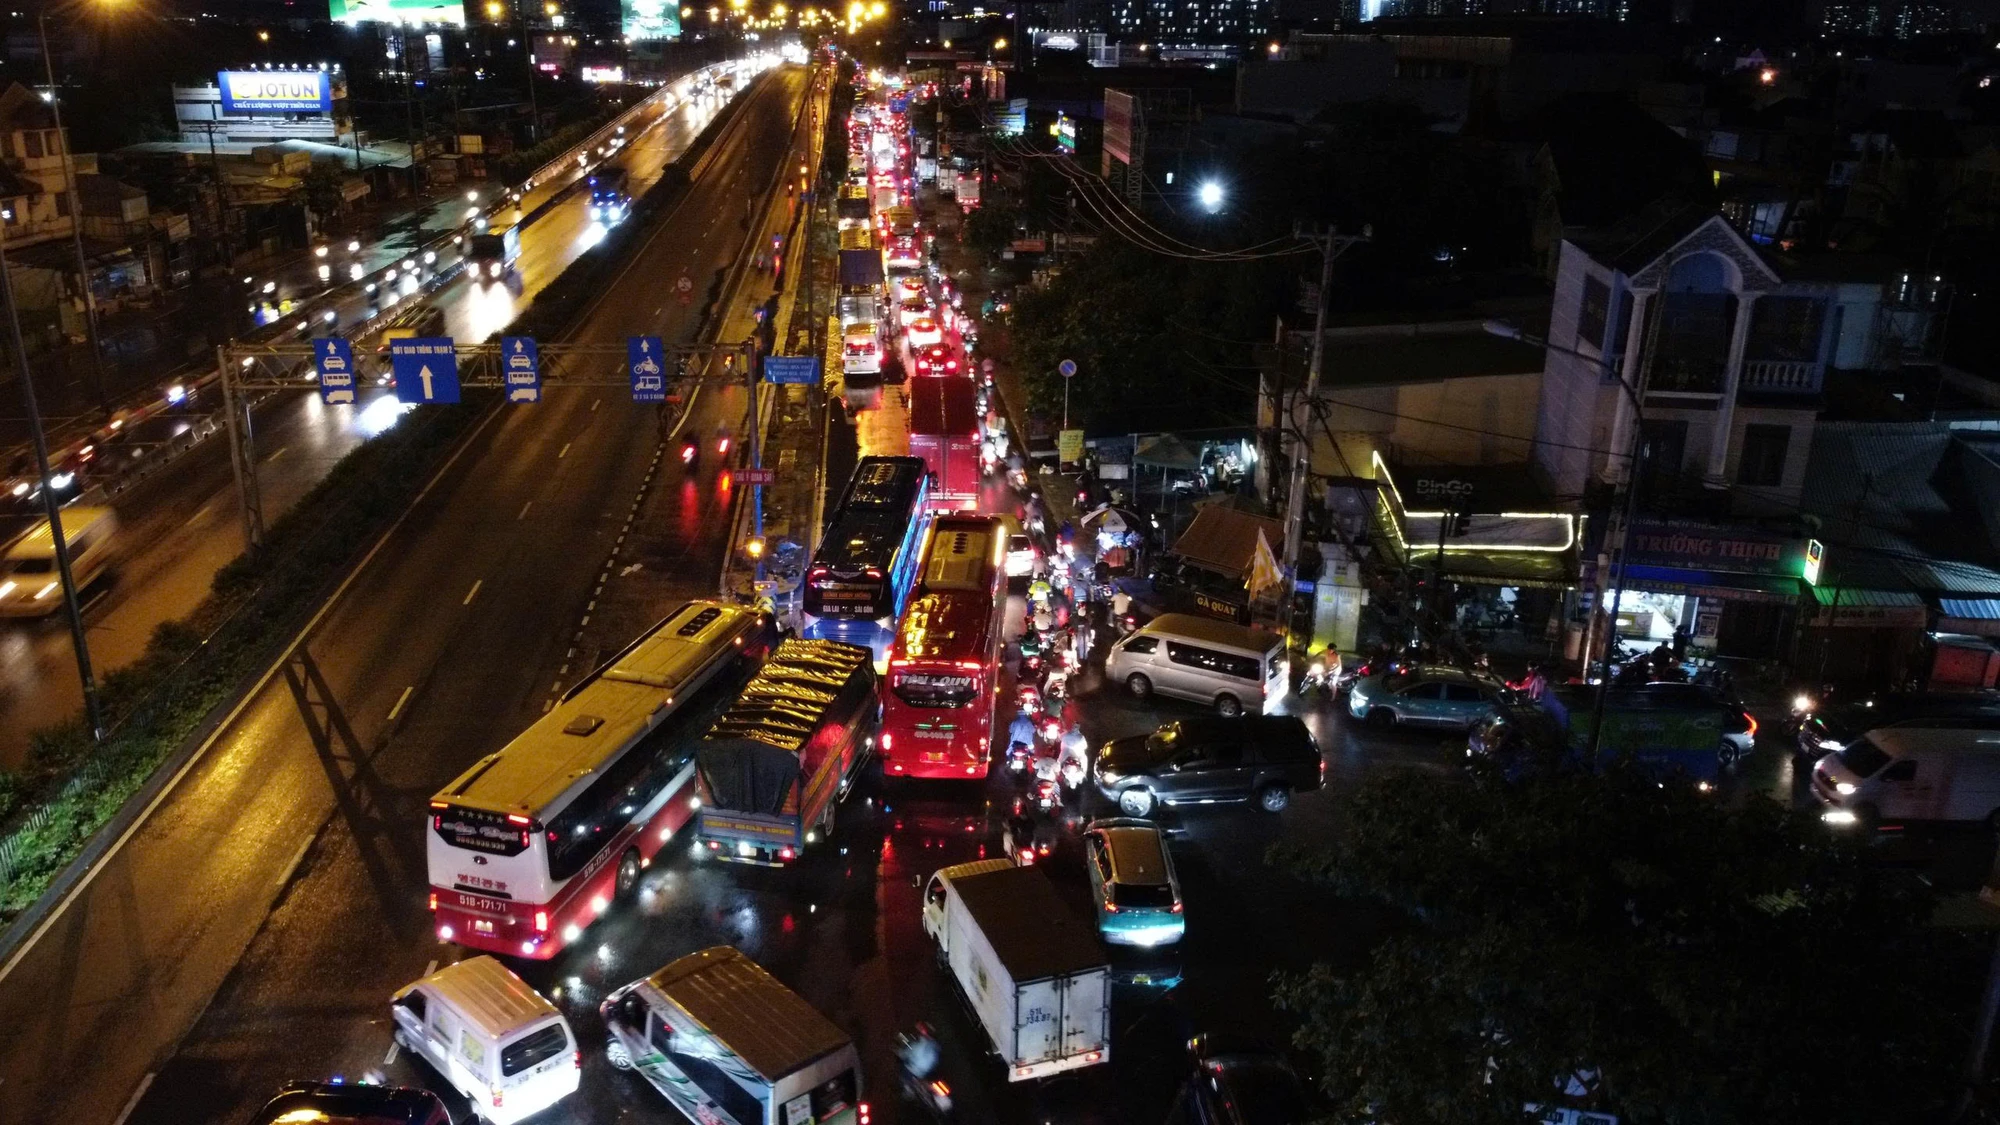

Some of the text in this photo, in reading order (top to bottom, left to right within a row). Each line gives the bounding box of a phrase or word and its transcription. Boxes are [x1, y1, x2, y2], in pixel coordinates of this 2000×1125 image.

[257, 83, 316, 98] JOTUN
[1416, 479, 1474, 495] BinGo
[1635, 533, 1782, 563] TRƯỜNG THỊNH
[822, 604, 832, 612] GIA
[854, 604, 864, 613] SÀI
[1211, 601, 1237, 616] QUAY
